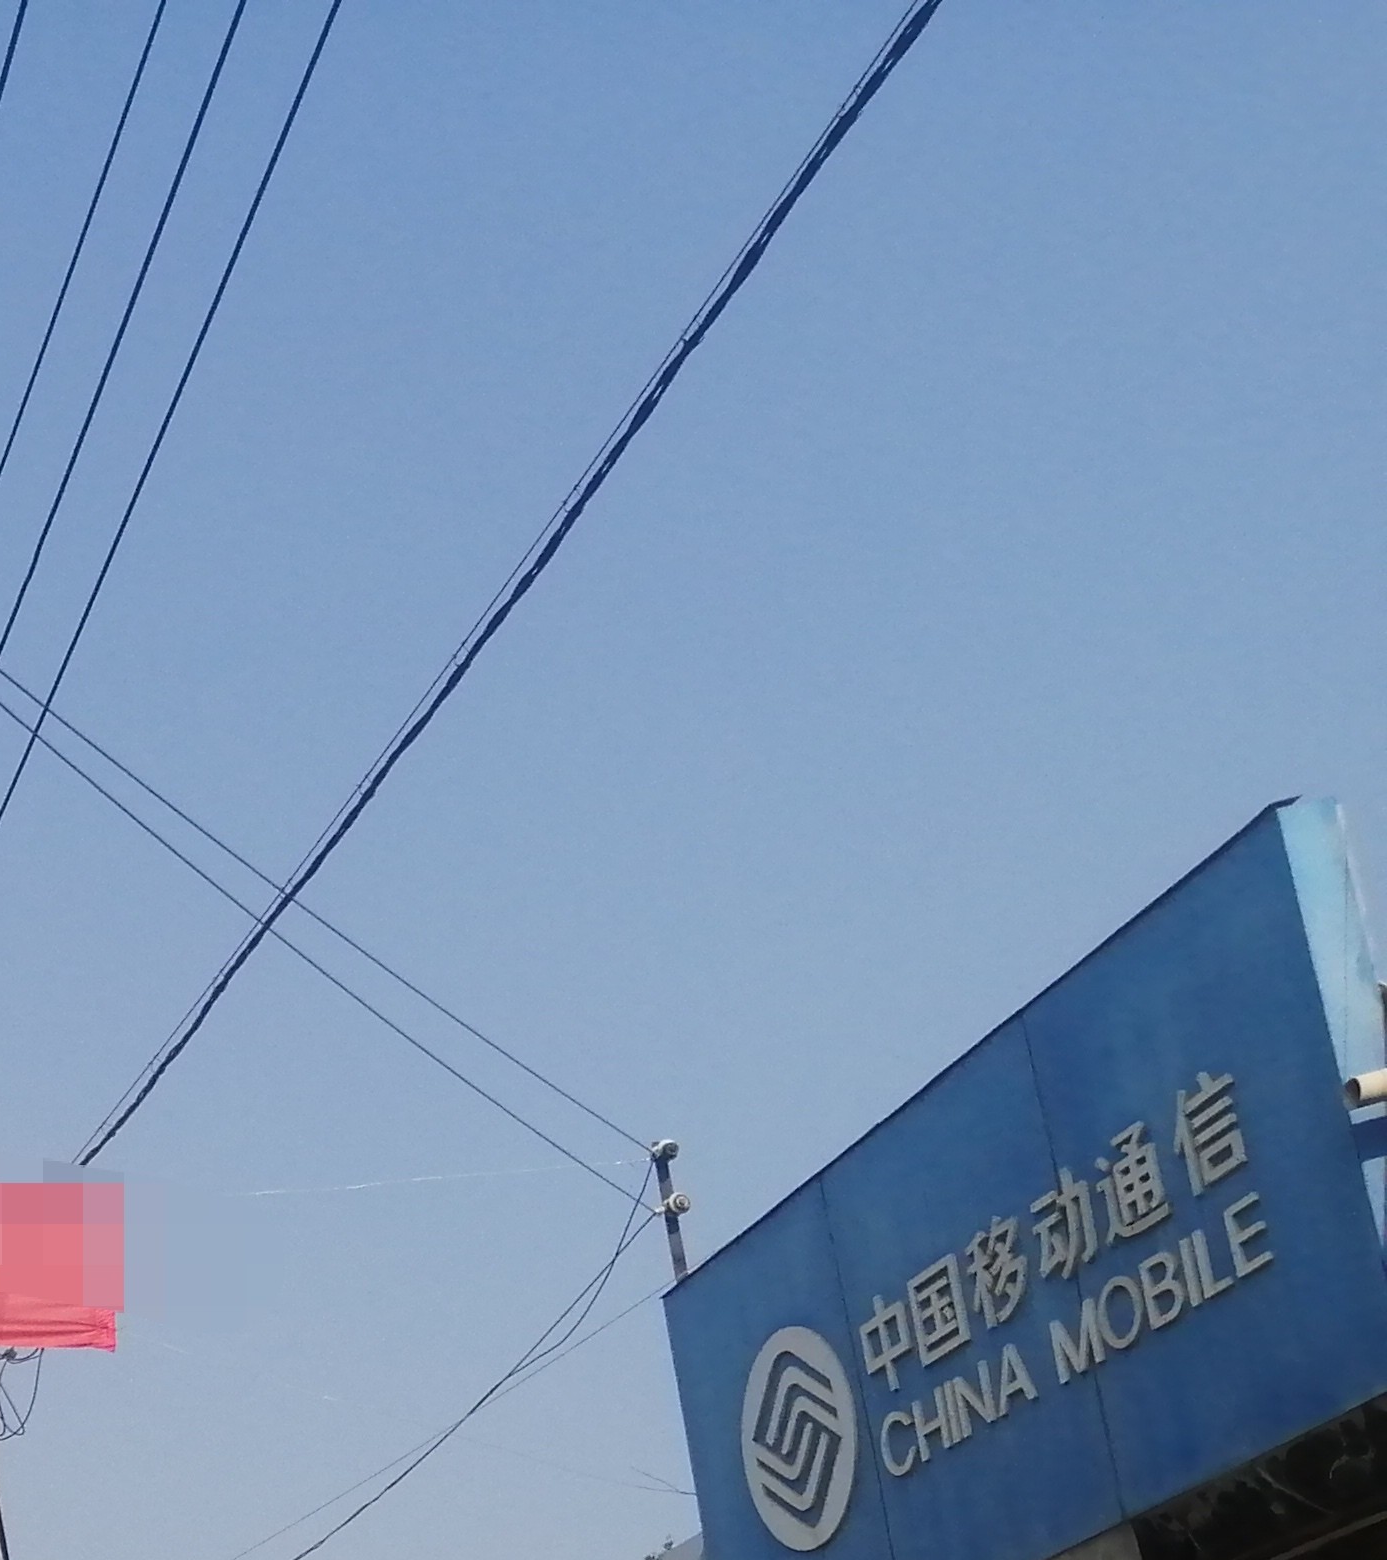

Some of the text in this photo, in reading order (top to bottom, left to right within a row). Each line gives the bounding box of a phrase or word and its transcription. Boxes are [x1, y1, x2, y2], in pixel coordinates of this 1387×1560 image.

[859, 1071, 1249, 1392] 中国移动通信
[880, 1191, 1274, 1477] CHINA MOBILE
